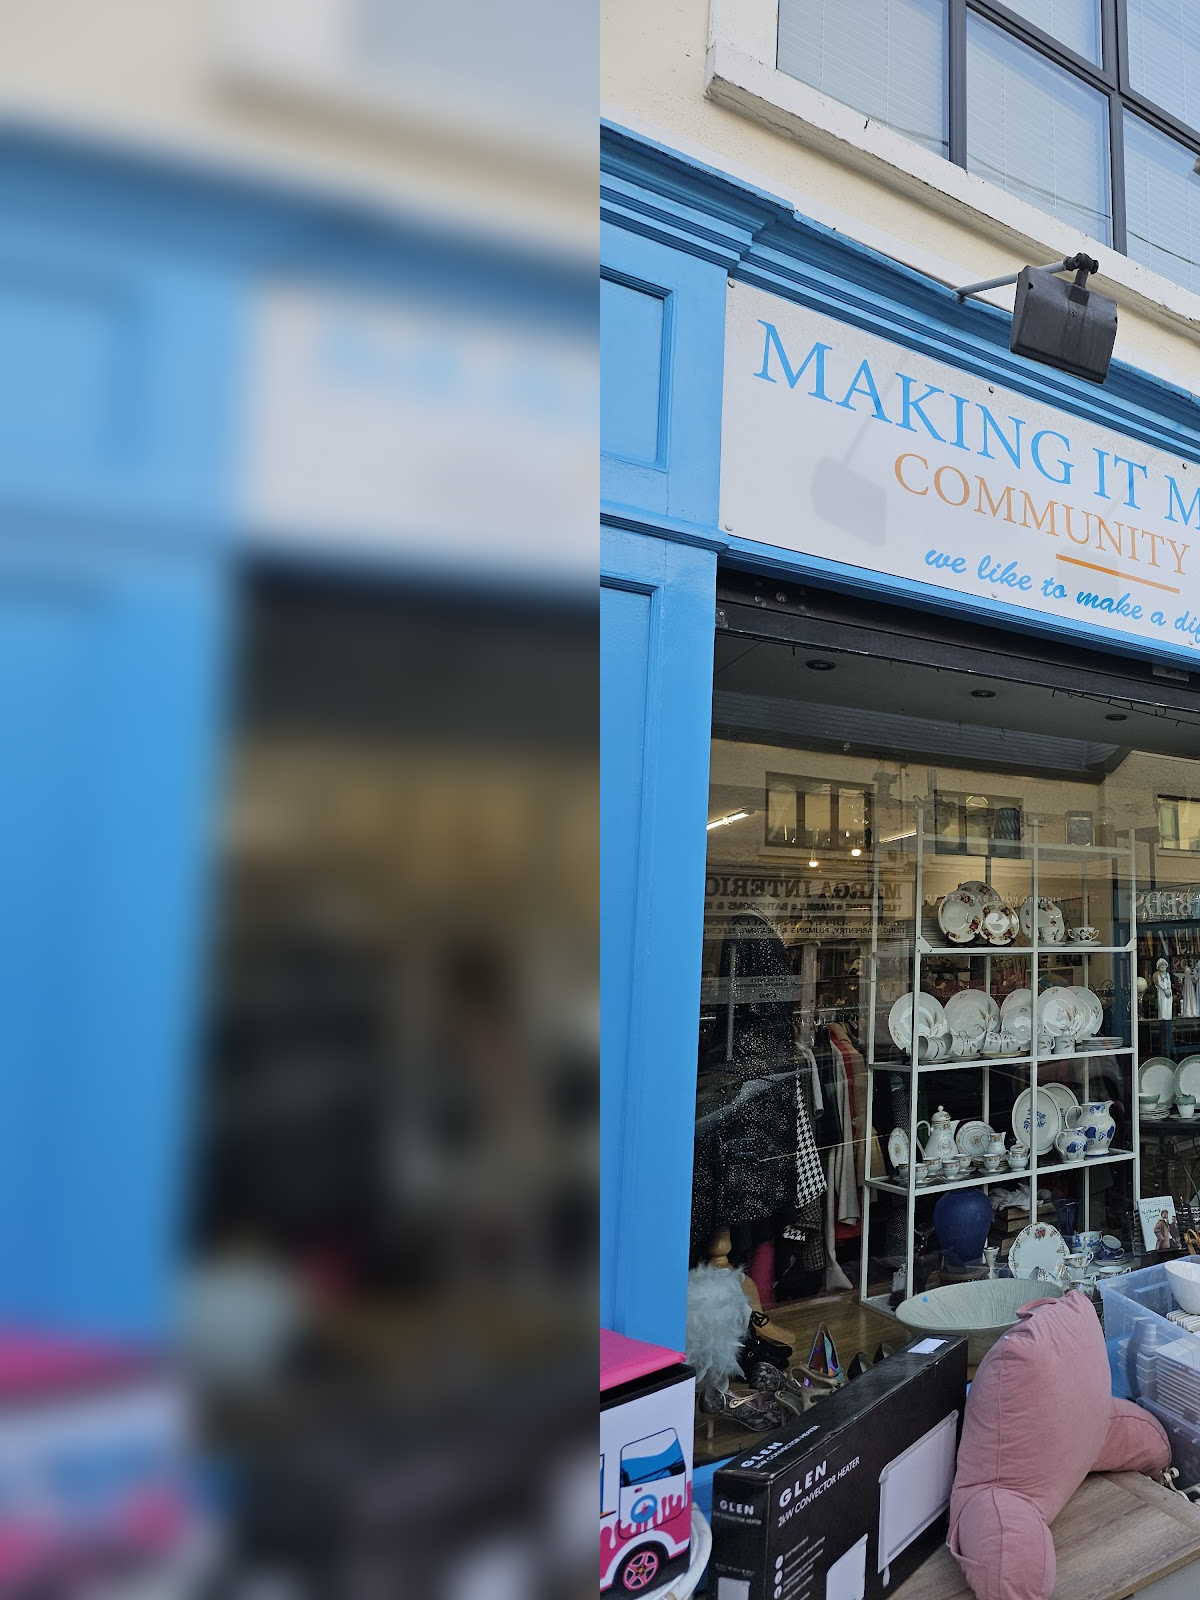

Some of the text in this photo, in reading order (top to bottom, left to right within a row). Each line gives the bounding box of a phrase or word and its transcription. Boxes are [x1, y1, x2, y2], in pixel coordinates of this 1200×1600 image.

[753, 319, 1074, 485] MAKING
[1093, 448, 1147, 509] IT
[894, 452, 1190, 575] COMMUNITY
[925, 549, 967, 573] we
[977, 555, 1032, 591] like
[1040, 579, 1067, 600] to
[1076, 590, 1144, 620] make
[1151, 611, 1166, 626] a
[741, 1442, 784, 1468] GLEN
[779, 1460, 827, 1508] GLEN
[719, 1500, 755, 1516] GLEN
[777, 1456, 860, 1528] 2kW CONVECTOR HEATER
